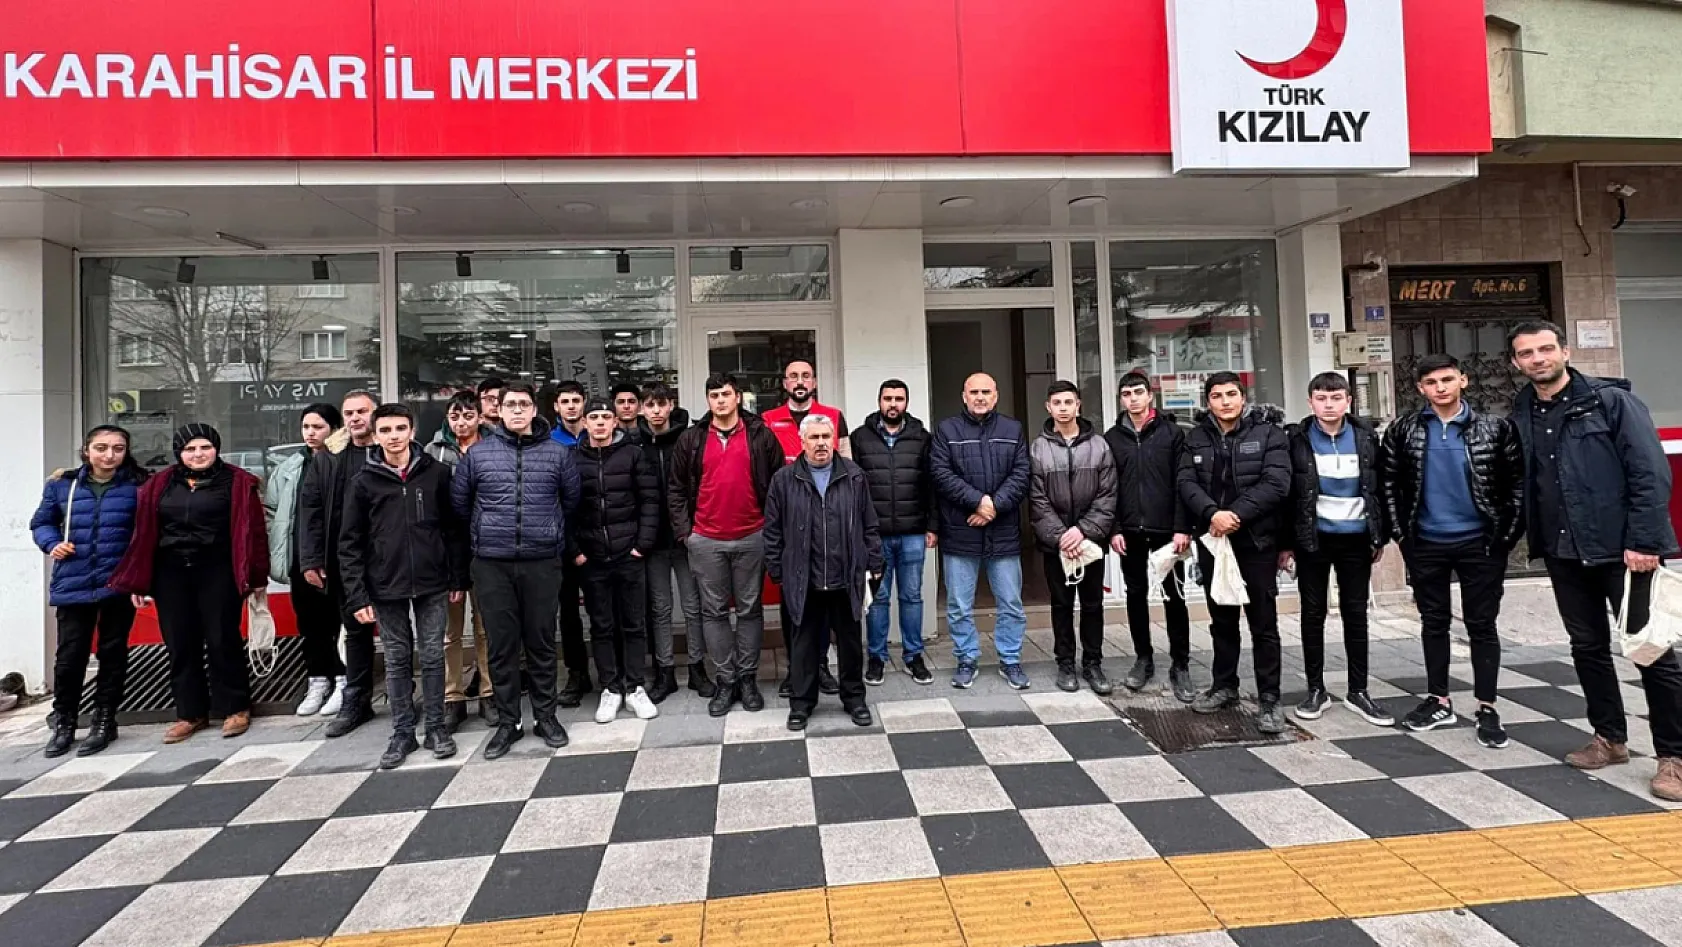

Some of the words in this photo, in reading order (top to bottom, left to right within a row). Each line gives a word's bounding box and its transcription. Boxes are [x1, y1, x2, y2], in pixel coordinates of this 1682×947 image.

[4, 43, 368, 99] KARAHİSAR
[384, 45, 435, 100] İL
[450, 47, 698, 100] MERKEZİ
[1262, 83, 1326, 106] TÜRK
[1217, 110, 1371, 143] KIZILAY
[1399, 279, 1457, 300] MERT
